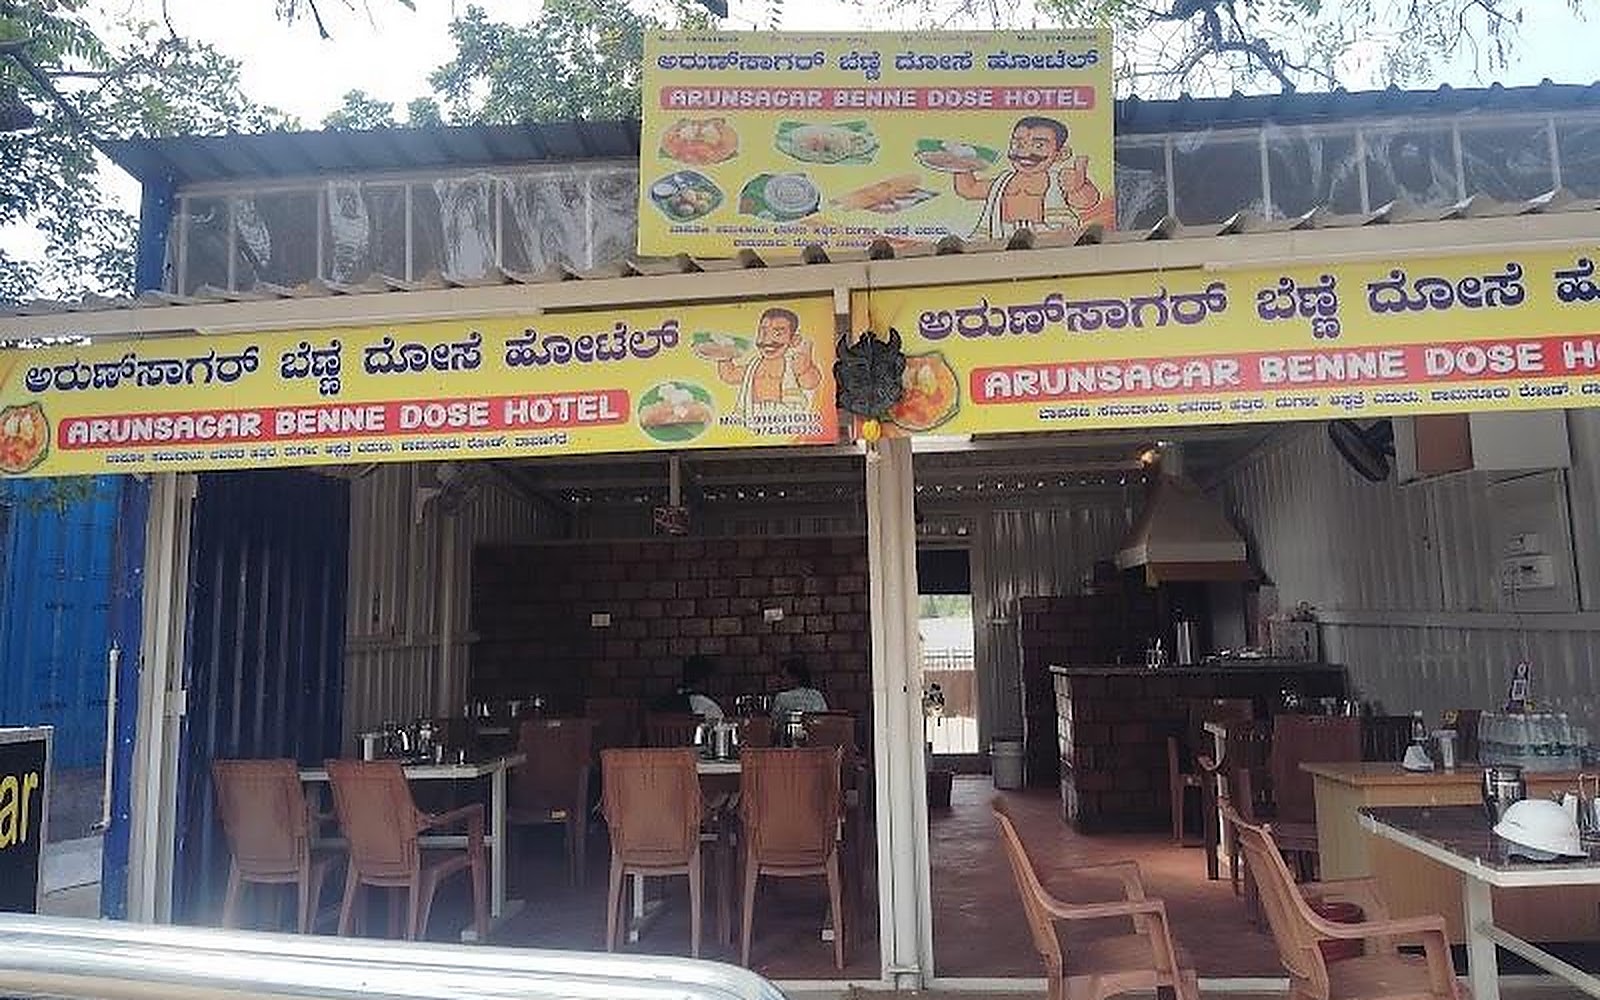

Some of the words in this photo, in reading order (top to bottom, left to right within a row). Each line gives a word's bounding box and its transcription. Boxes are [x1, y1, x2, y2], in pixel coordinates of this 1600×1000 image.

[839, 51, 881, 82] ಬೆಣ್ಣೆ
[896, 51, 973, 71] ದೋಸೆ
[989, 50, 1099, 71] ಹೋಟೆಲ್
[670, 88, 823, 108] ARUNSAGAR
[834, 88, 917, 107] BENNE
[928, 88, 993, 107] DOSE
[1004, 88, 1088, 107] HOTEL
[1256, 274, 1342, 339] ಬೆಣ್ಣೆ
[1367, 261, 1527, 313] ದೋಸೆ
[281, 339, 342, 396] ಬೆಣ್ಣೆ
[363, 331, 483, 375] ದೋಸೆ
[505, 319, 680, 368] ಹೋಟೆಲ್
[984, 358, 1241, 398] ARUNSAGAR
[1259, 350, 1407, 383] BENNE
[1424, 343, 1544, 376] DOSE
[1562, 340, 1600, 370] H
[67, 413, 263, 445] ARUNSAGAR
[276, 405, 386, 436] BENNE
[400, 400, 490, 429] DOSE
[504, 393, 620, 424] HOTEL
